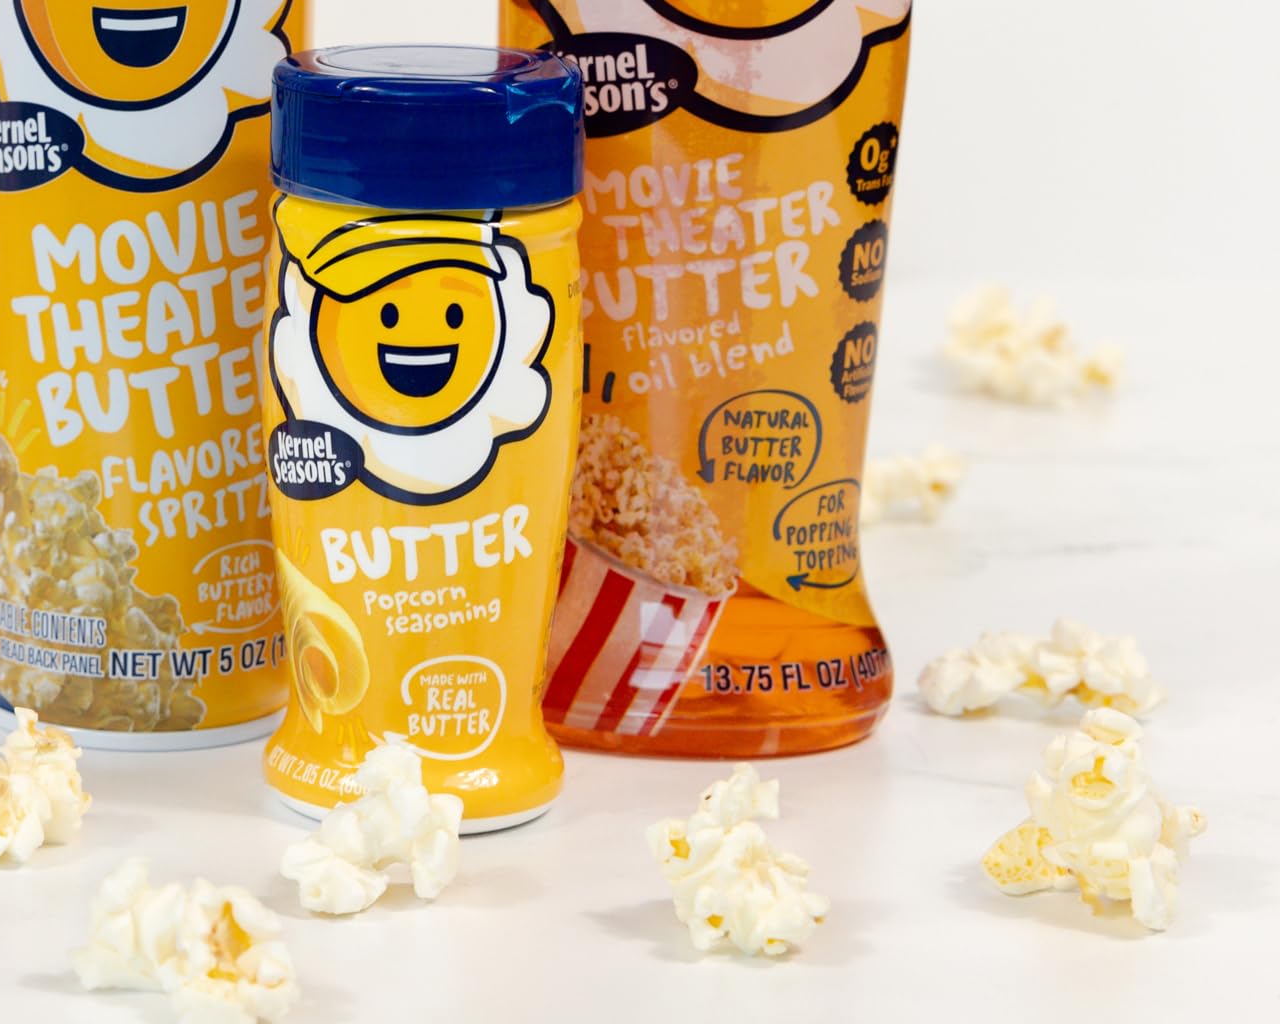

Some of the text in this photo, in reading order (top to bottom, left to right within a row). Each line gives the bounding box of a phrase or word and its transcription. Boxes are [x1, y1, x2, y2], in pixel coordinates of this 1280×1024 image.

[558, 44, 655, 82] rnel
[584, 80, 669, 116] son's
[583, 153, 744, 214] MOVIE
[602, 181, 841, 261] THEATER
[31, 190, 265, 292] MOVIE
[853, 239, 884, 271] NO
[11, 254, 268, 369] THEATE
[622, 309, 741, 352] flavored
[628, 321, 794, 394] oil blend
[844, 336, 875, 368] NO
[37, 330, 263, 447] BUTTE
[724, 409, 810, 429] NATURAL
[102, 424, 266, 498] FLAVORE
[278, 431, 336, 460] Kernel
[722, 435, 802, 457] BUTTER
[724, 460, 796, 483] FLAVOR
[817, 489, 846, 516] FOR
[321, 504, 532, 583] BUTTER
[220, 552, 260, 578] RICH
[198, 572, 274, 603] BUTTERY
[363, 584, 467, 616] Popcorn
[216, 595, 273, 623] FLAVOR
[385, 597, 501, 636] seasoning
[33, 610, 105, 646] CONTENTS
[28, 646, 58, 670] BACK
[62, 654, 102, 676] PANEL
[111, 652, 162, 677] NET
[172, 649, 212, 676] WT
[220, 650, 233, 673] 5
[241, 639, 265, 669] OZ
[420, 672, 487, 686] MADE WITH
[701, 665, 771, 691] 13.75
[782, 664, 810, 690] FL
[819, 659, 846, 687] OZ
[426, 689, 476, 712] REAL
[407, 710, 490, 737] BUTTER
[320, 768, 340, 790] OZ
